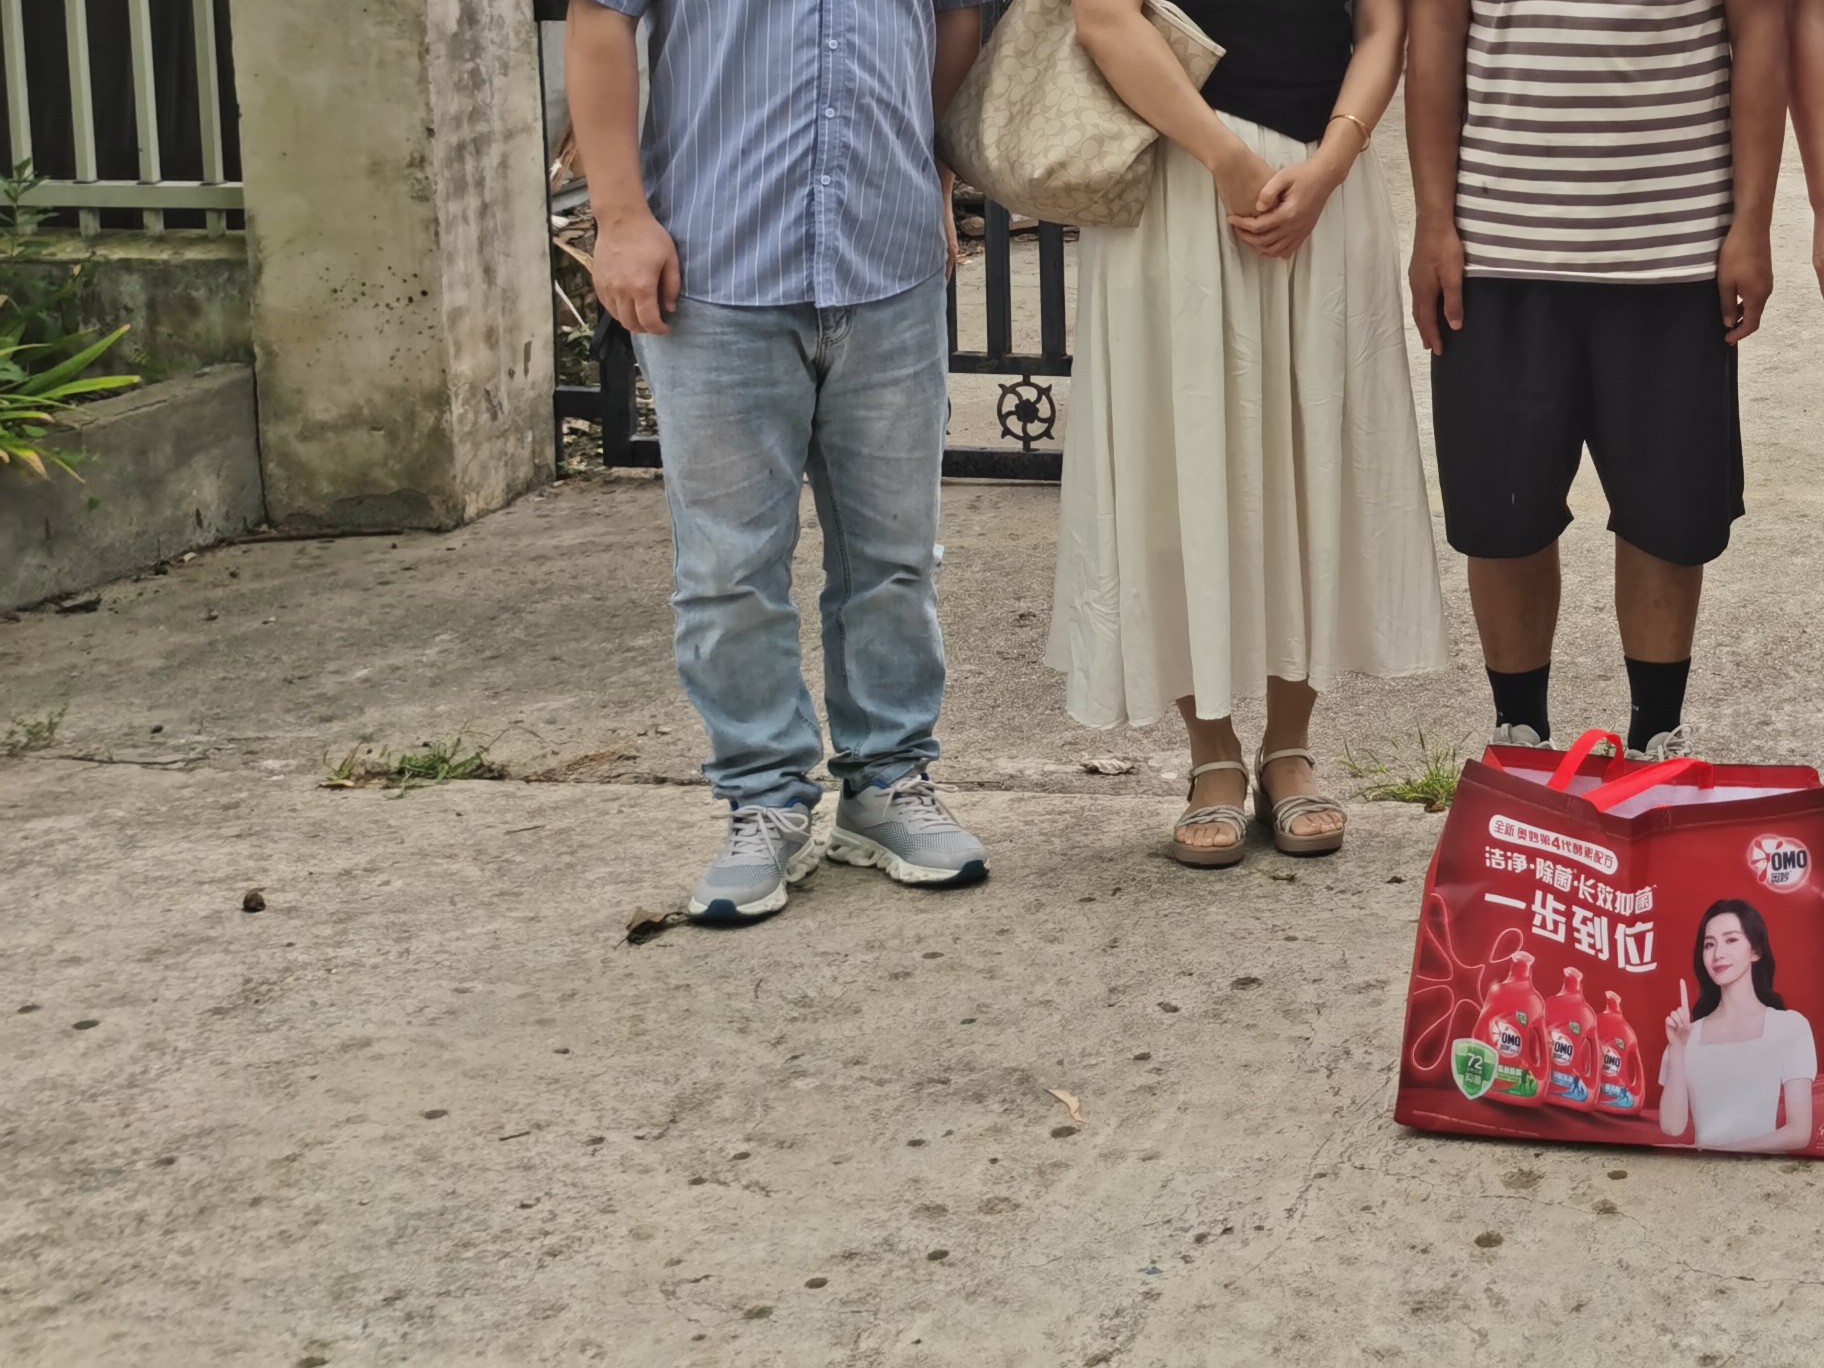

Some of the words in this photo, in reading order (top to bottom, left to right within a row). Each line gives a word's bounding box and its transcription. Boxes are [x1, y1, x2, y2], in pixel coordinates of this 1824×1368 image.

[1494, 819, 1515, 837] 全新
[1771, 849, 1808, 871] OMO
[1484, 889, 1658, 973] 一步到位
[1501, 1033, 1521, 1047] OMO
[1554, 1041, 1573, 1056] OMO
[1467, 1053, 1483, 1070] 72
[1603, 1053, 1621, 1067] OMO
